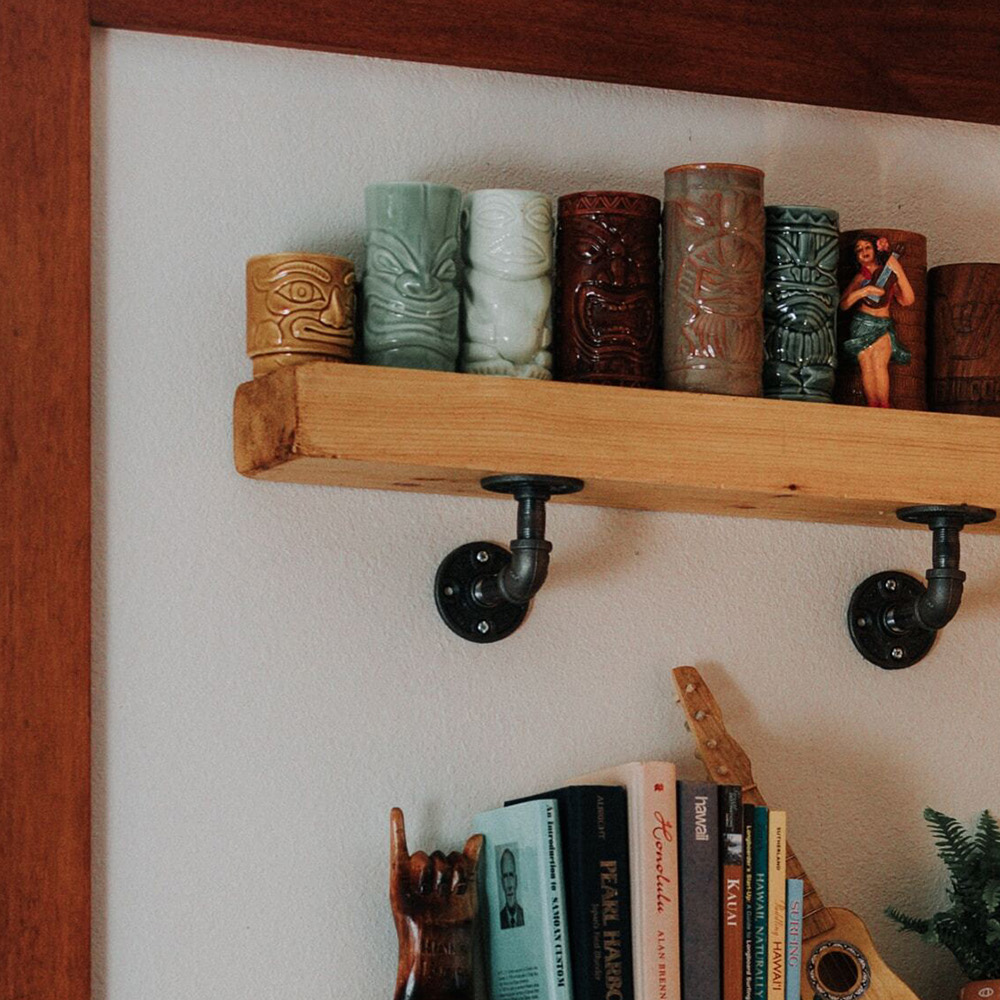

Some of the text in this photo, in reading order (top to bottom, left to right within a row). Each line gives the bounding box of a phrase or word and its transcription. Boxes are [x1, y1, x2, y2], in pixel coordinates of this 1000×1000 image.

[546, 805, 553, 818] An
[596, 795, 606, 840] ALBRIGHT
[694, 795, 709, 841] hawaii
[652, 811, 673, 914] Honolulu
[745, 825, 753, 872] Longboarder's
[551, 881, 558, 891] to
[599, 860, 619, 926] PEARL
[727, 878, 740, 926] KAUAI
[551, 896, 563, 941] SAMOAN
[789, 901, 800, 967] SURFING
[555, 944, 566, 988] CUSTOM
[657, 930, 666, 961] ALAN
[744, 940, 752, 975] Longboard
[754, 926, 765, 998] NATURALLY
[744, 977, 752, 1000] Surfing
